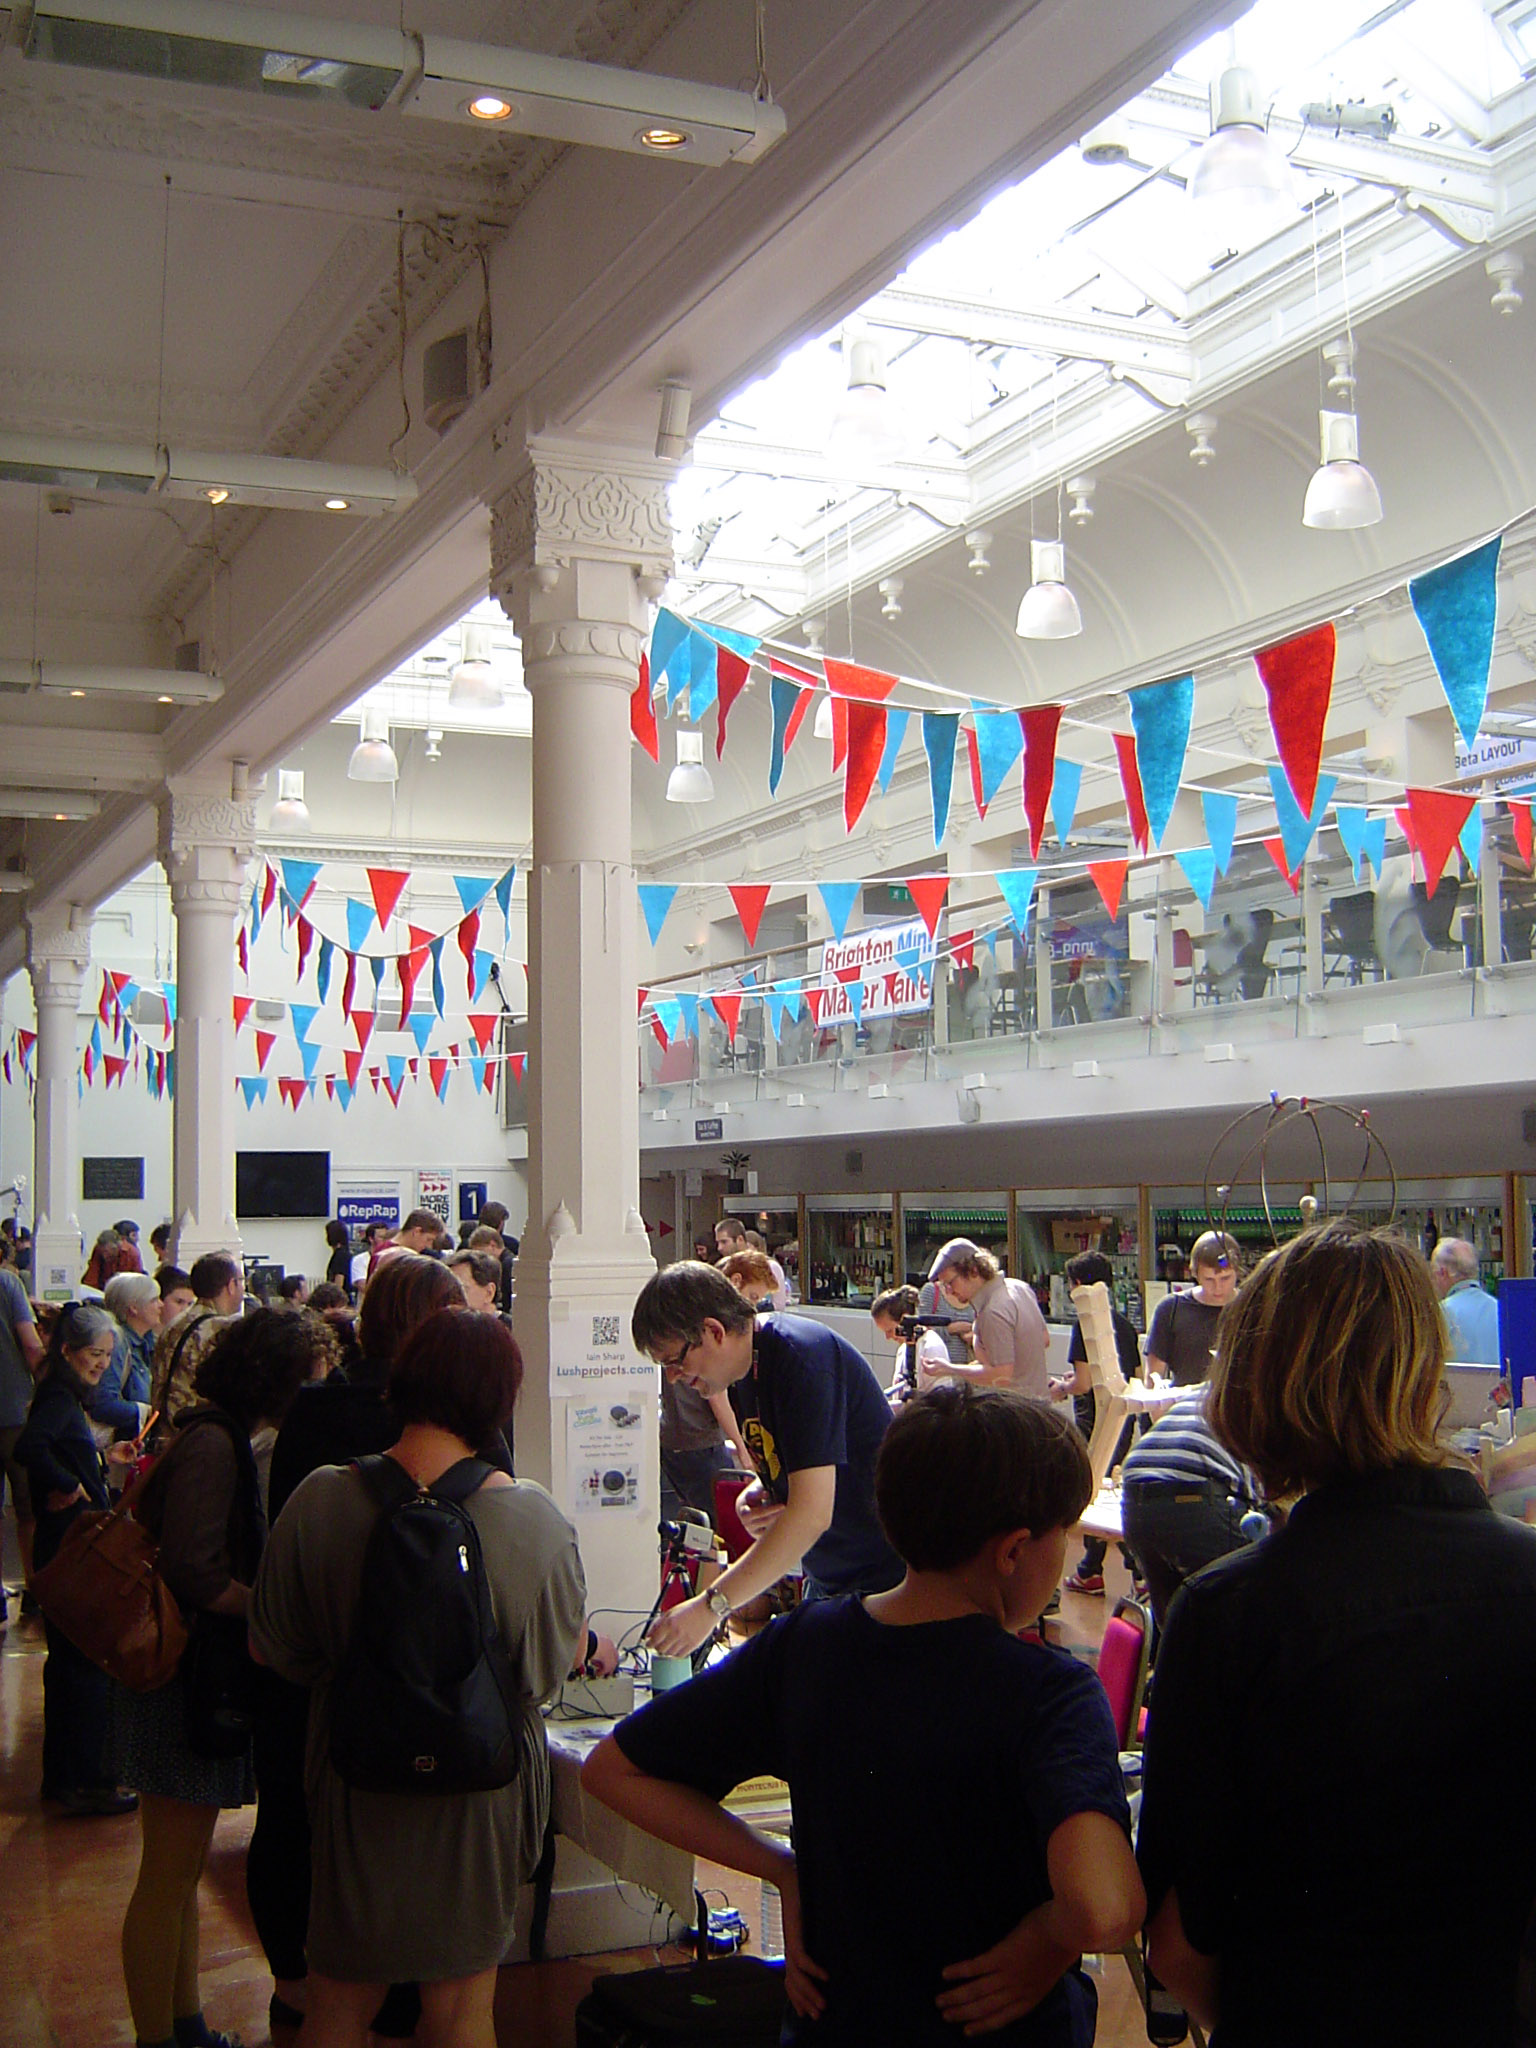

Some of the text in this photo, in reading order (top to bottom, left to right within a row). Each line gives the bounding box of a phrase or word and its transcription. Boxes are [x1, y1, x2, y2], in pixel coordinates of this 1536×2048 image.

[1455, 740, 1522, 769] Beta LAYOUT
[825, 938, 893, 972] Brighton
[822, 982, 879, 1018] Maer
[420, 1194, 450, 1203] MORE
[467, 1190, 478, 1215] 1
[349, 1204, 398, 1220] RepRap
[603, 1353, 625, 1361] Sharp
[556, 1365, 654, 1379] Lushprojects.com
